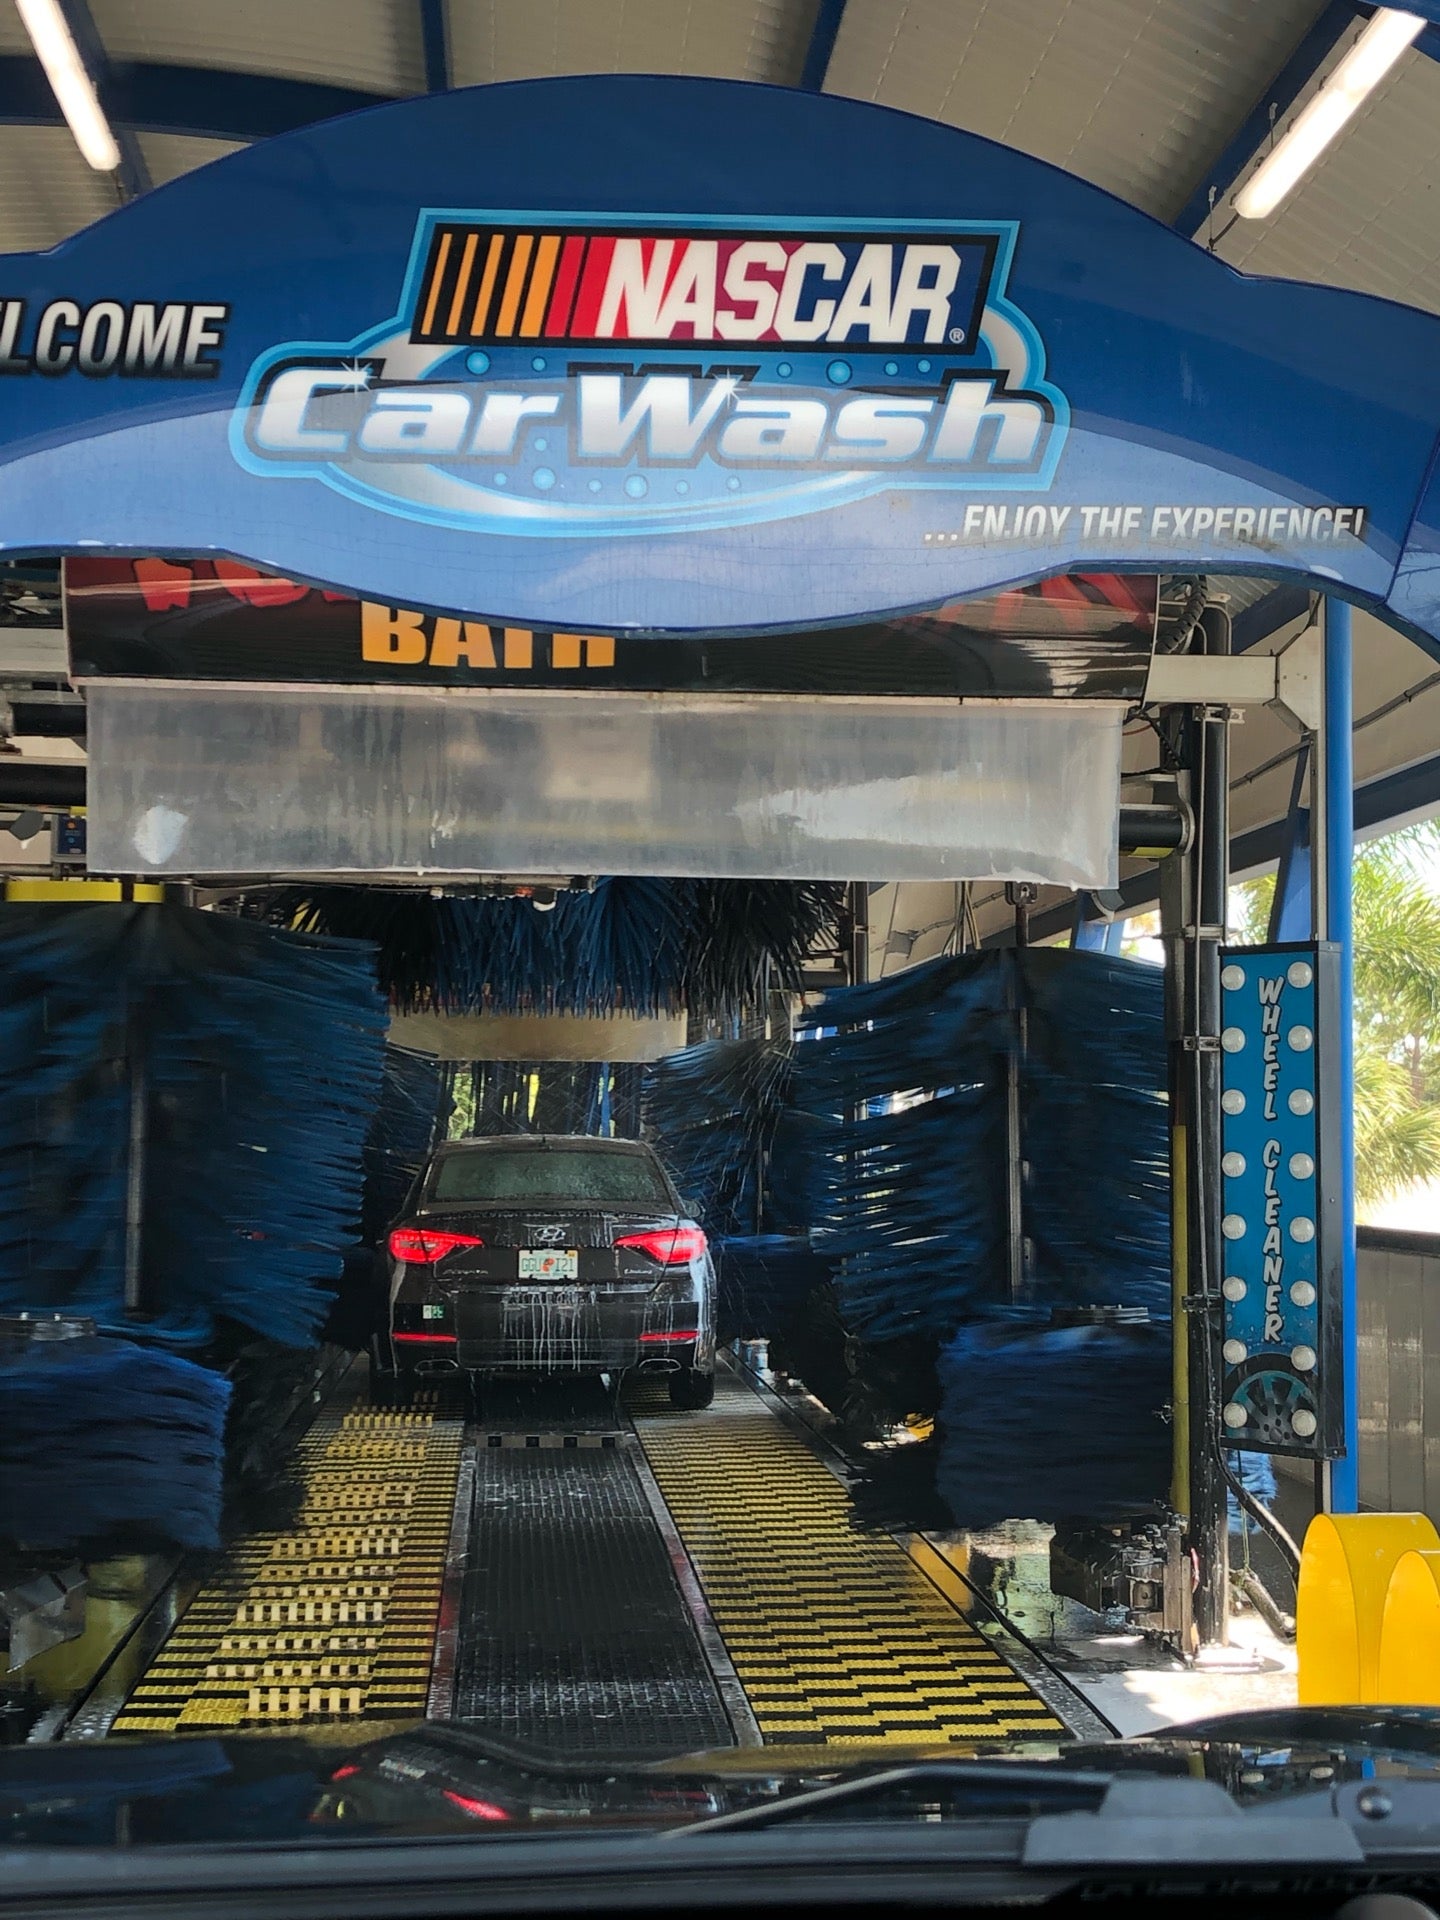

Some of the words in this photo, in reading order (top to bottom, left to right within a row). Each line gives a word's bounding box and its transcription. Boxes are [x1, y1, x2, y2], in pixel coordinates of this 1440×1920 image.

[0, 300, 226, 376] LCOME
[1079, 505, 1142, 542] THE
[1150, 506, 1366, 543] EXPERIENCE!
[1257, 975, 1286, 1121] WHEEL
[1262, 1139, 1283, 1343] CLEANER
